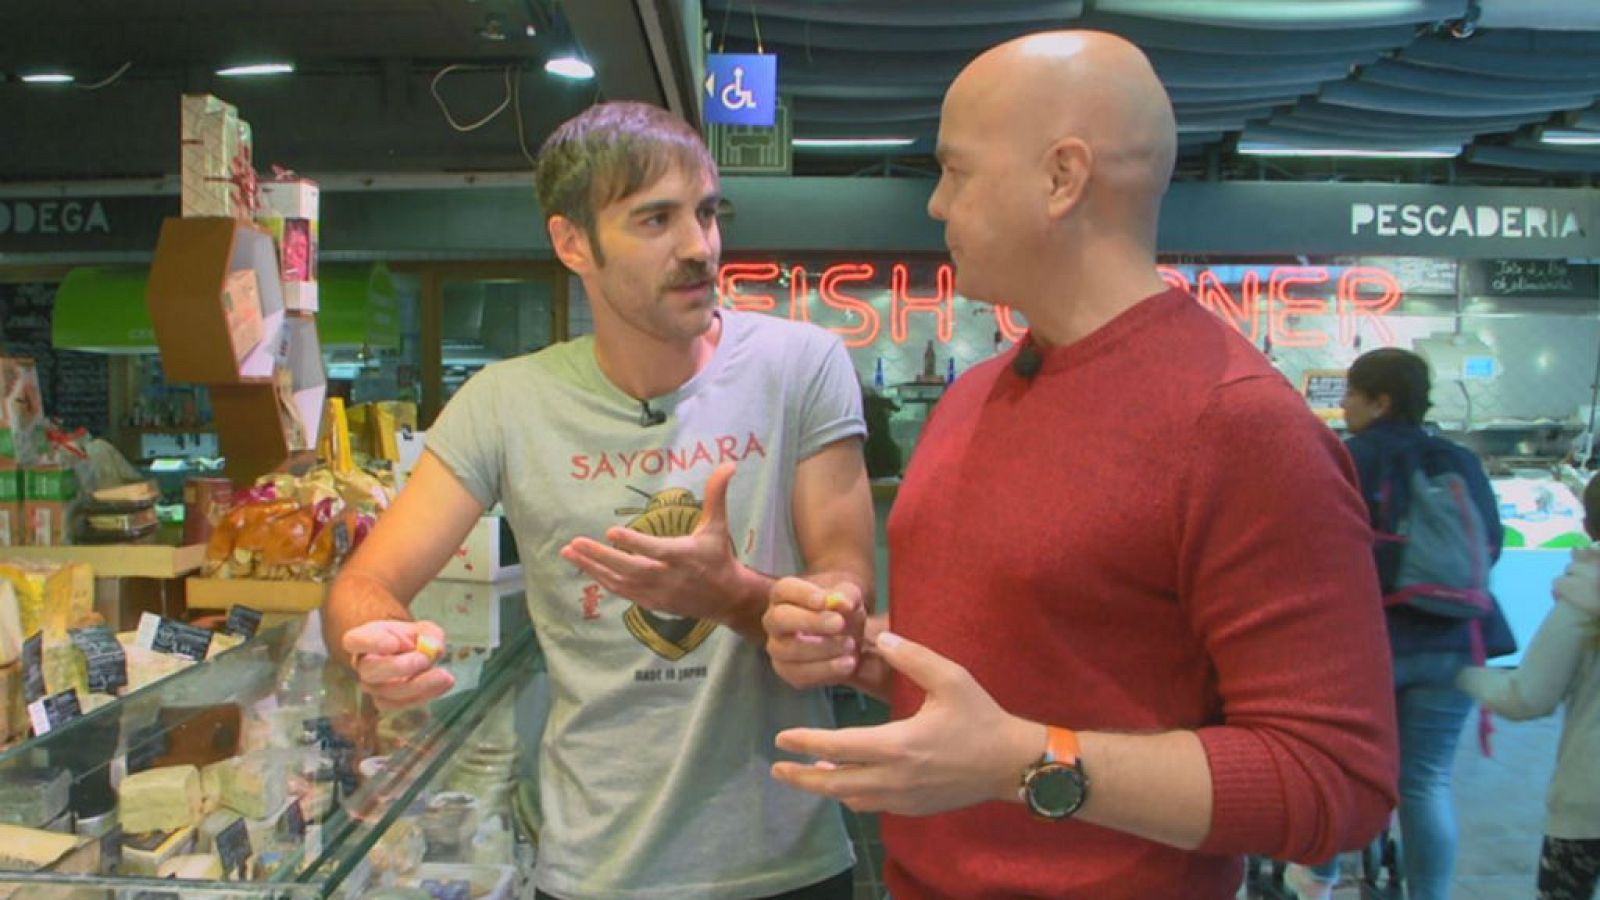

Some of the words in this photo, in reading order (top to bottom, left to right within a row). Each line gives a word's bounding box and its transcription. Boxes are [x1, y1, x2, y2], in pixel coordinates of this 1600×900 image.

[1351, 203, 1586, 238] PESCADERIA
[719, 263, 956, 347] FISH
[570, 431, 766, 480] SAYONARA
